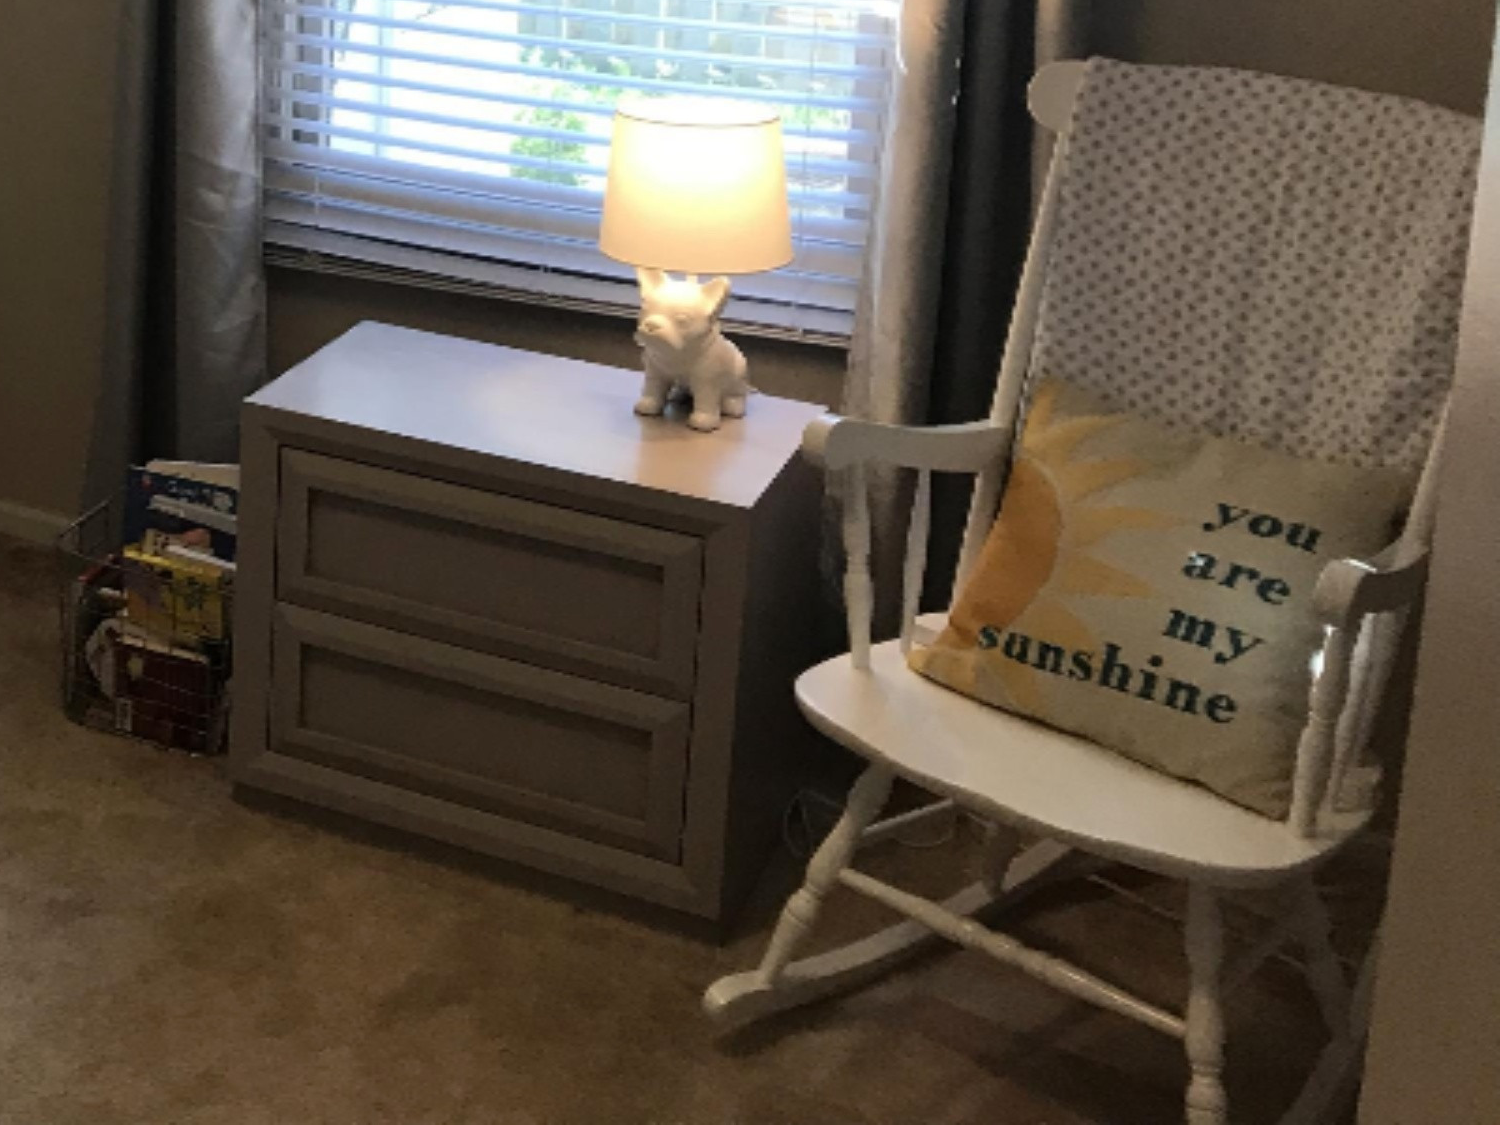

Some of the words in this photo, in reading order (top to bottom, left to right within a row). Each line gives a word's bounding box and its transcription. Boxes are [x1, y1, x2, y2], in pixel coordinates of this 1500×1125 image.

[1203, 503, 1322, 554] you
[1182, 551, 1291, 605] are
[1162, 608, 1265, 665] my
[977, 624, 1238, 724] sunshine
